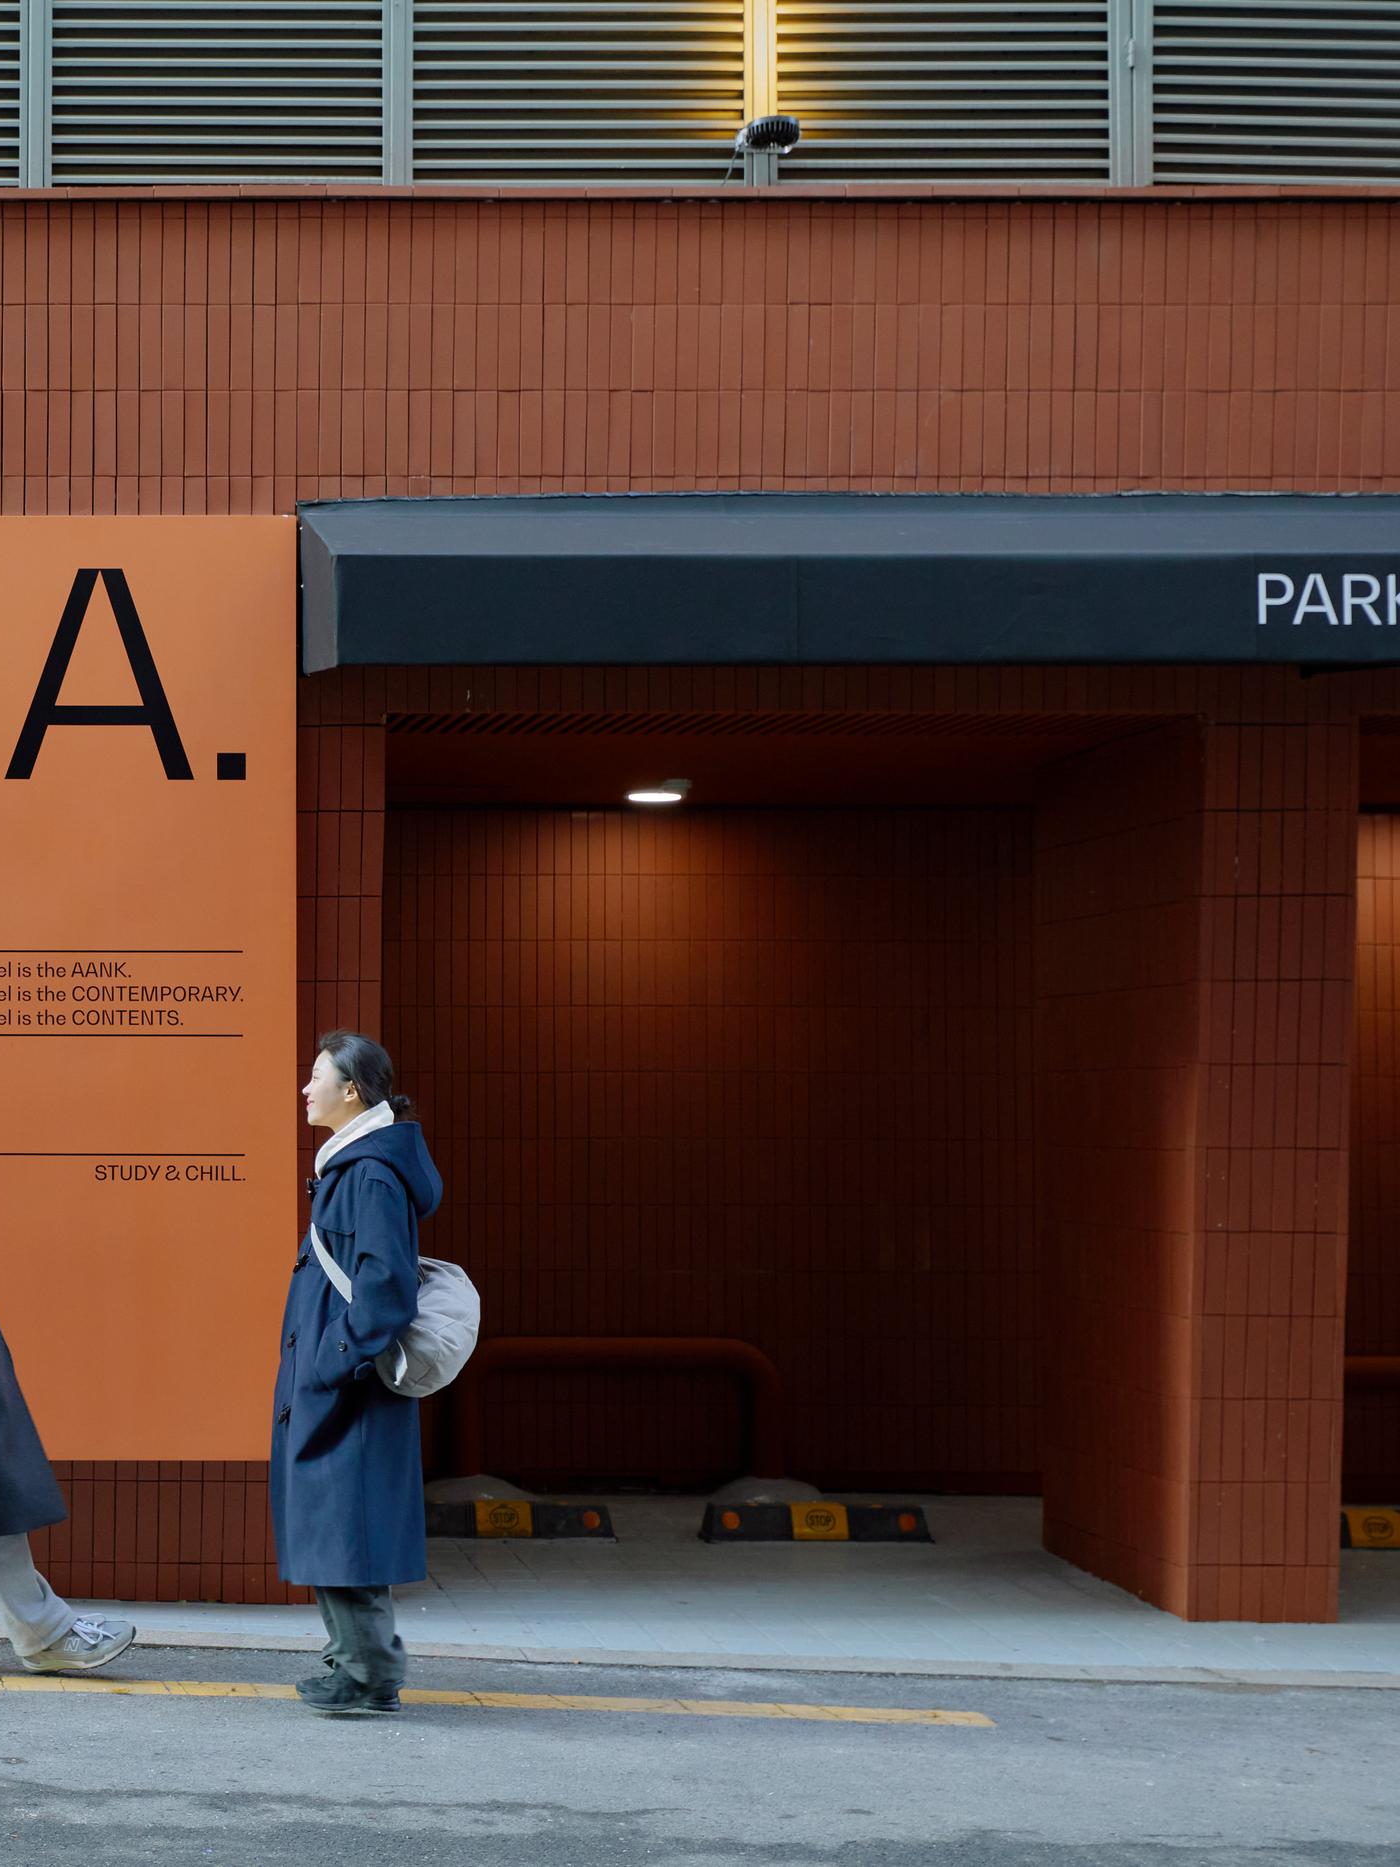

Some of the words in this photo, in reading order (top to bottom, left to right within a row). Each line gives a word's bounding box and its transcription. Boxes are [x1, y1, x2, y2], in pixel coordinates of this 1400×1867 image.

[4, 567, 247, 781] A.
[17, 962, 32, 978] is
[36, 961, 67, 978] the
[71, 961, 132, 978] AANK.
[17, 986, 32, 1002] is
[36, 985, 67, 1002] the
[71, 985, 244, 1003] CONTEMPORARY.
[17, 1010, 32, 1026] is
[36, 1009, 67, 1026] the
[71, 1009, 184, 1026] CONTENTS.
[94, 1164, 161, 1182] STUDY
[164, 1164, 181, 1182] &
[185, 1164, 246, 1182] CHILL.
[808, 1515, 832, 1527] STOP
[64, 1637, 80, 1652] N
